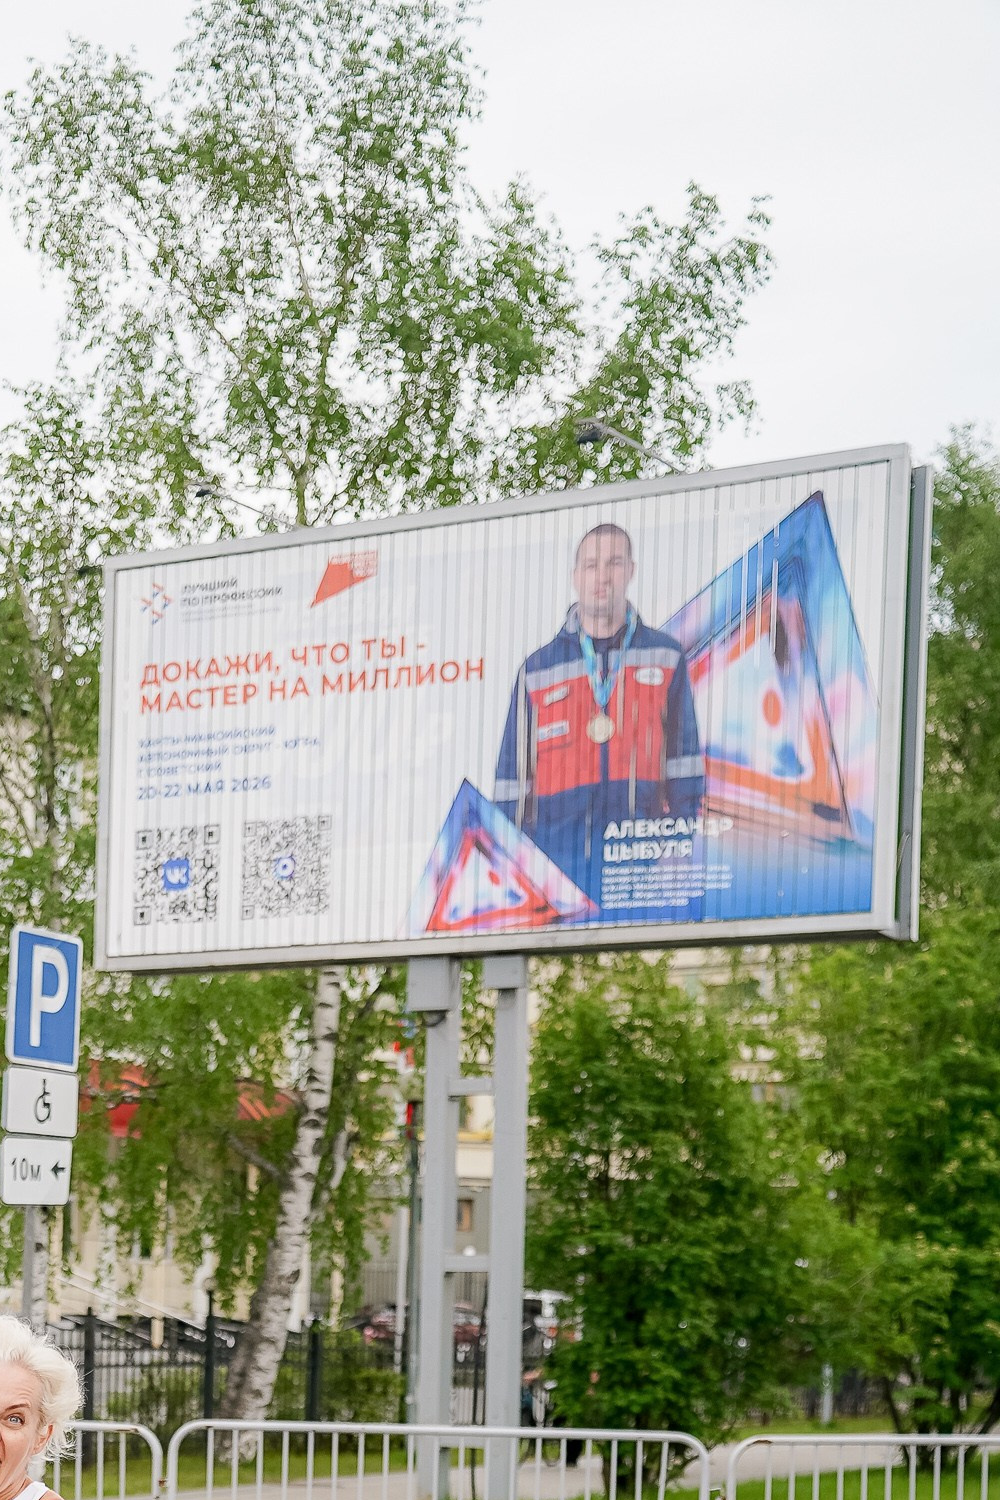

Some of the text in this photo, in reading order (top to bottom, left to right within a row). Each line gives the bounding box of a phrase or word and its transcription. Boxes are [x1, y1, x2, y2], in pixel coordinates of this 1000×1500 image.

[140, 651, 281, 689] ДОКАЖИ,
[291, 642, 350, 667] ЧТО
[361, 636, 405, 661] ТЫ
[140, 657, 485, 715] МАСТЕР НА МИЛЛИОН
[187, 779, 225, 794] МАЯ
[231, 775, 272, 793] 2026
[603, 816, 734, 840] АЛЕКСАНДР
[603, 839, 693, 863] ЦЫБУЛЯ
[29, 943, 70, 1048] P
